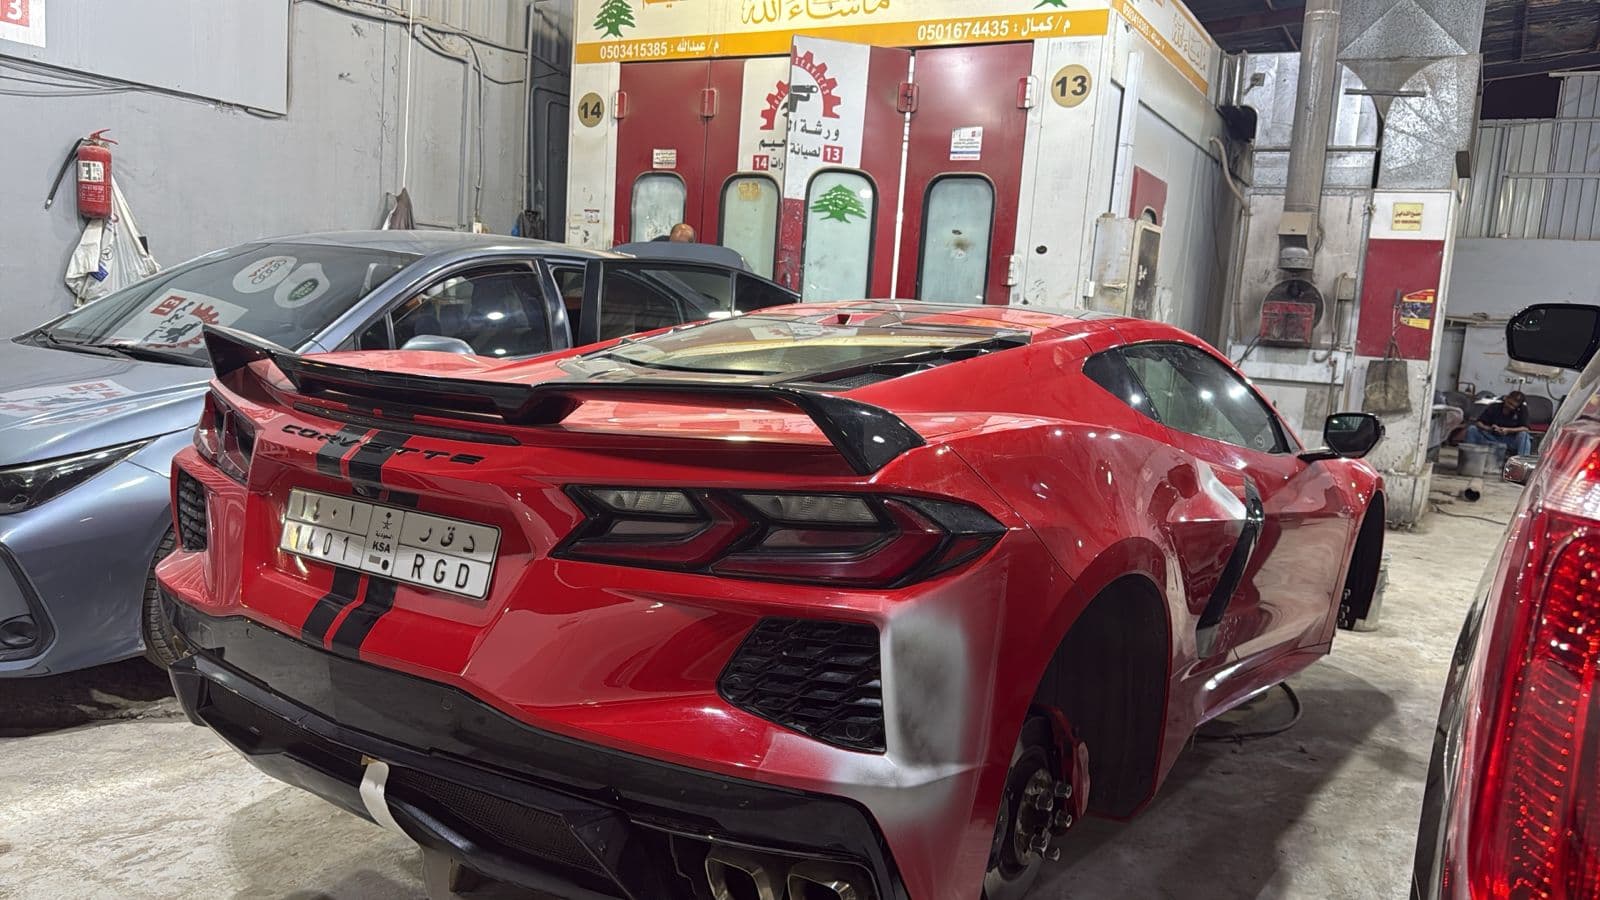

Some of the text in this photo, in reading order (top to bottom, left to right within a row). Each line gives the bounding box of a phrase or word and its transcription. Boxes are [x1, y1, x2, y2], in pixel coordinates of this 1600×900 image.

[917, 19, 1009, 41] 0501674435
[600, 41, 668, 60] 0503415385
[1055, 75, 1087, 97] 13
[580, 102, 602, 119] 14
[800, 118, 840, 141] ورشة
[789, 142, 841, 161] 13 لصيانة
[754, 157, 768, 169] 14
[281, 423, 486, 465] CORVETTE
[294, 526, 350, 561] 1401
[372, 540, 391, 554] KSA
[411, 553, 471, 589] RGD
